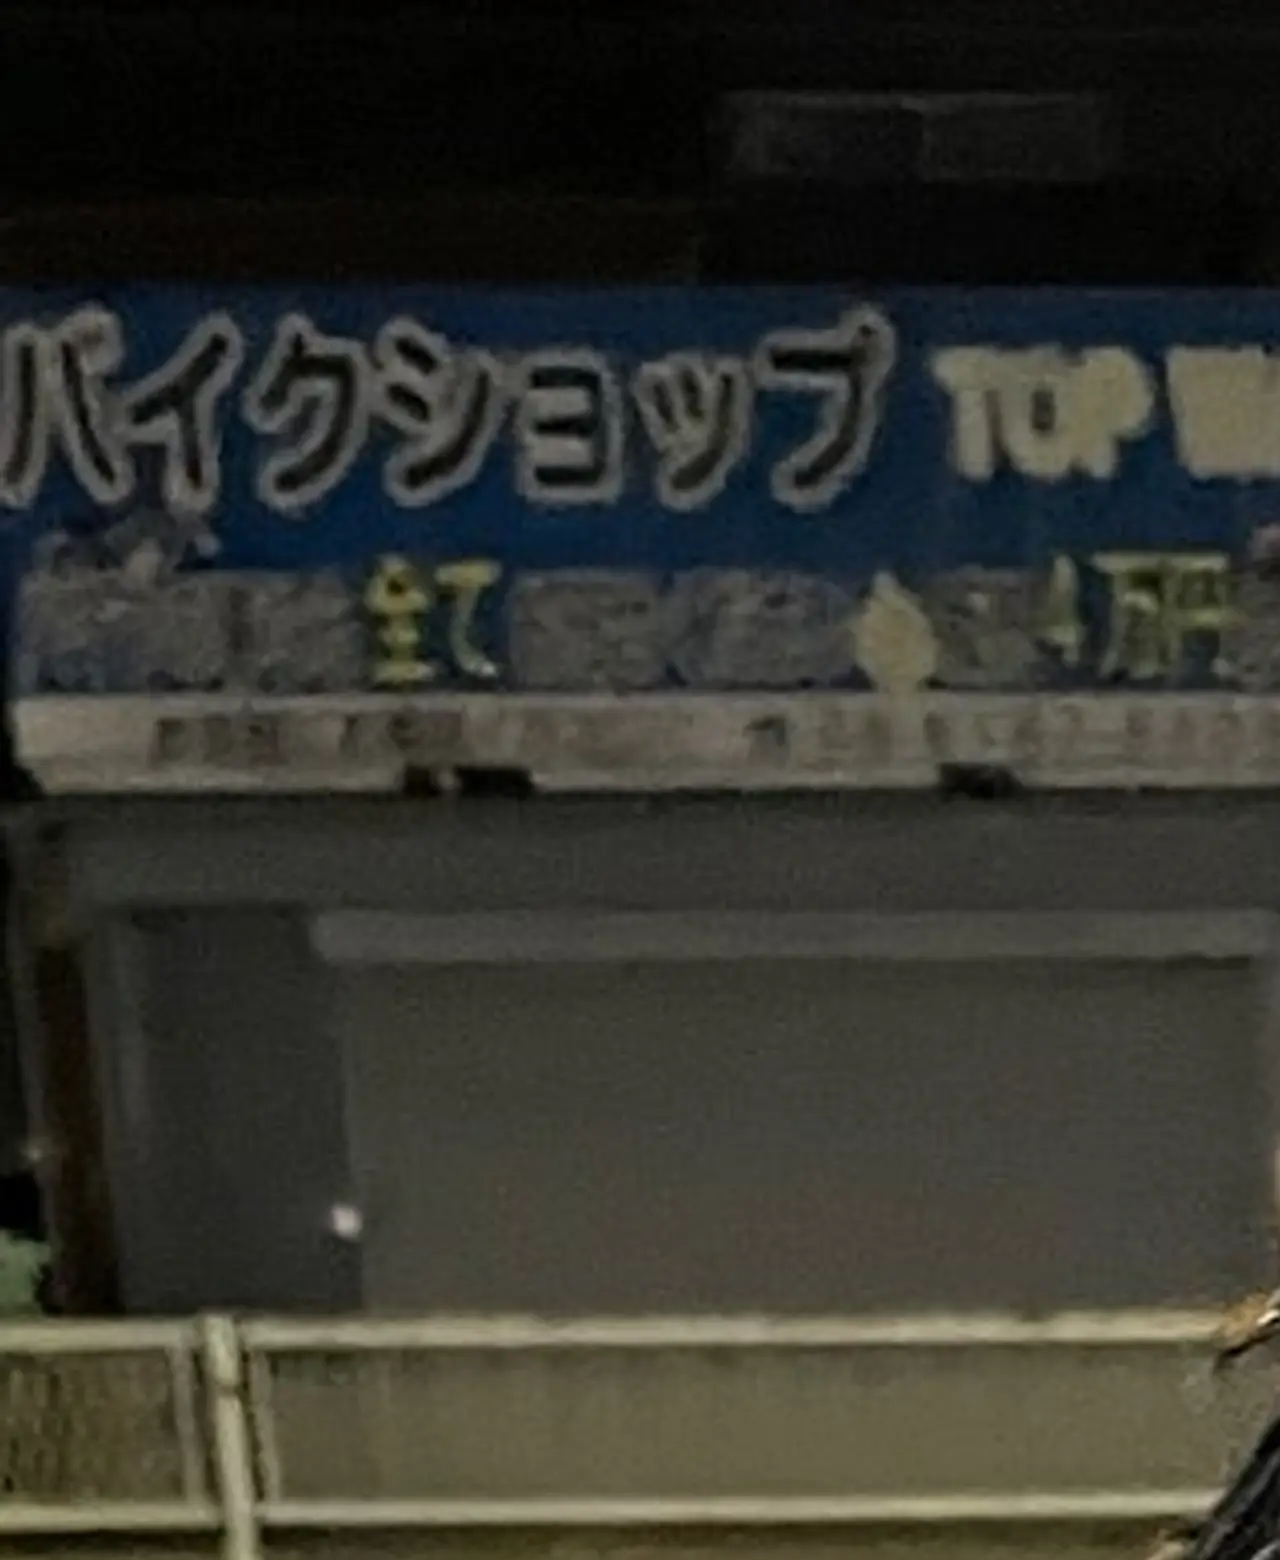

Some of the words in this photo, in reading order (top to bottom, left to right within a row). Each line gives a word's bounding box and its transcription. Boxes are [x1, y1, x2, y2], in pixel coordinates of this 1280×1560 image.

[0, 303, 896, 514] バイクショップ
[931, 344, 1154, 482] TOP
